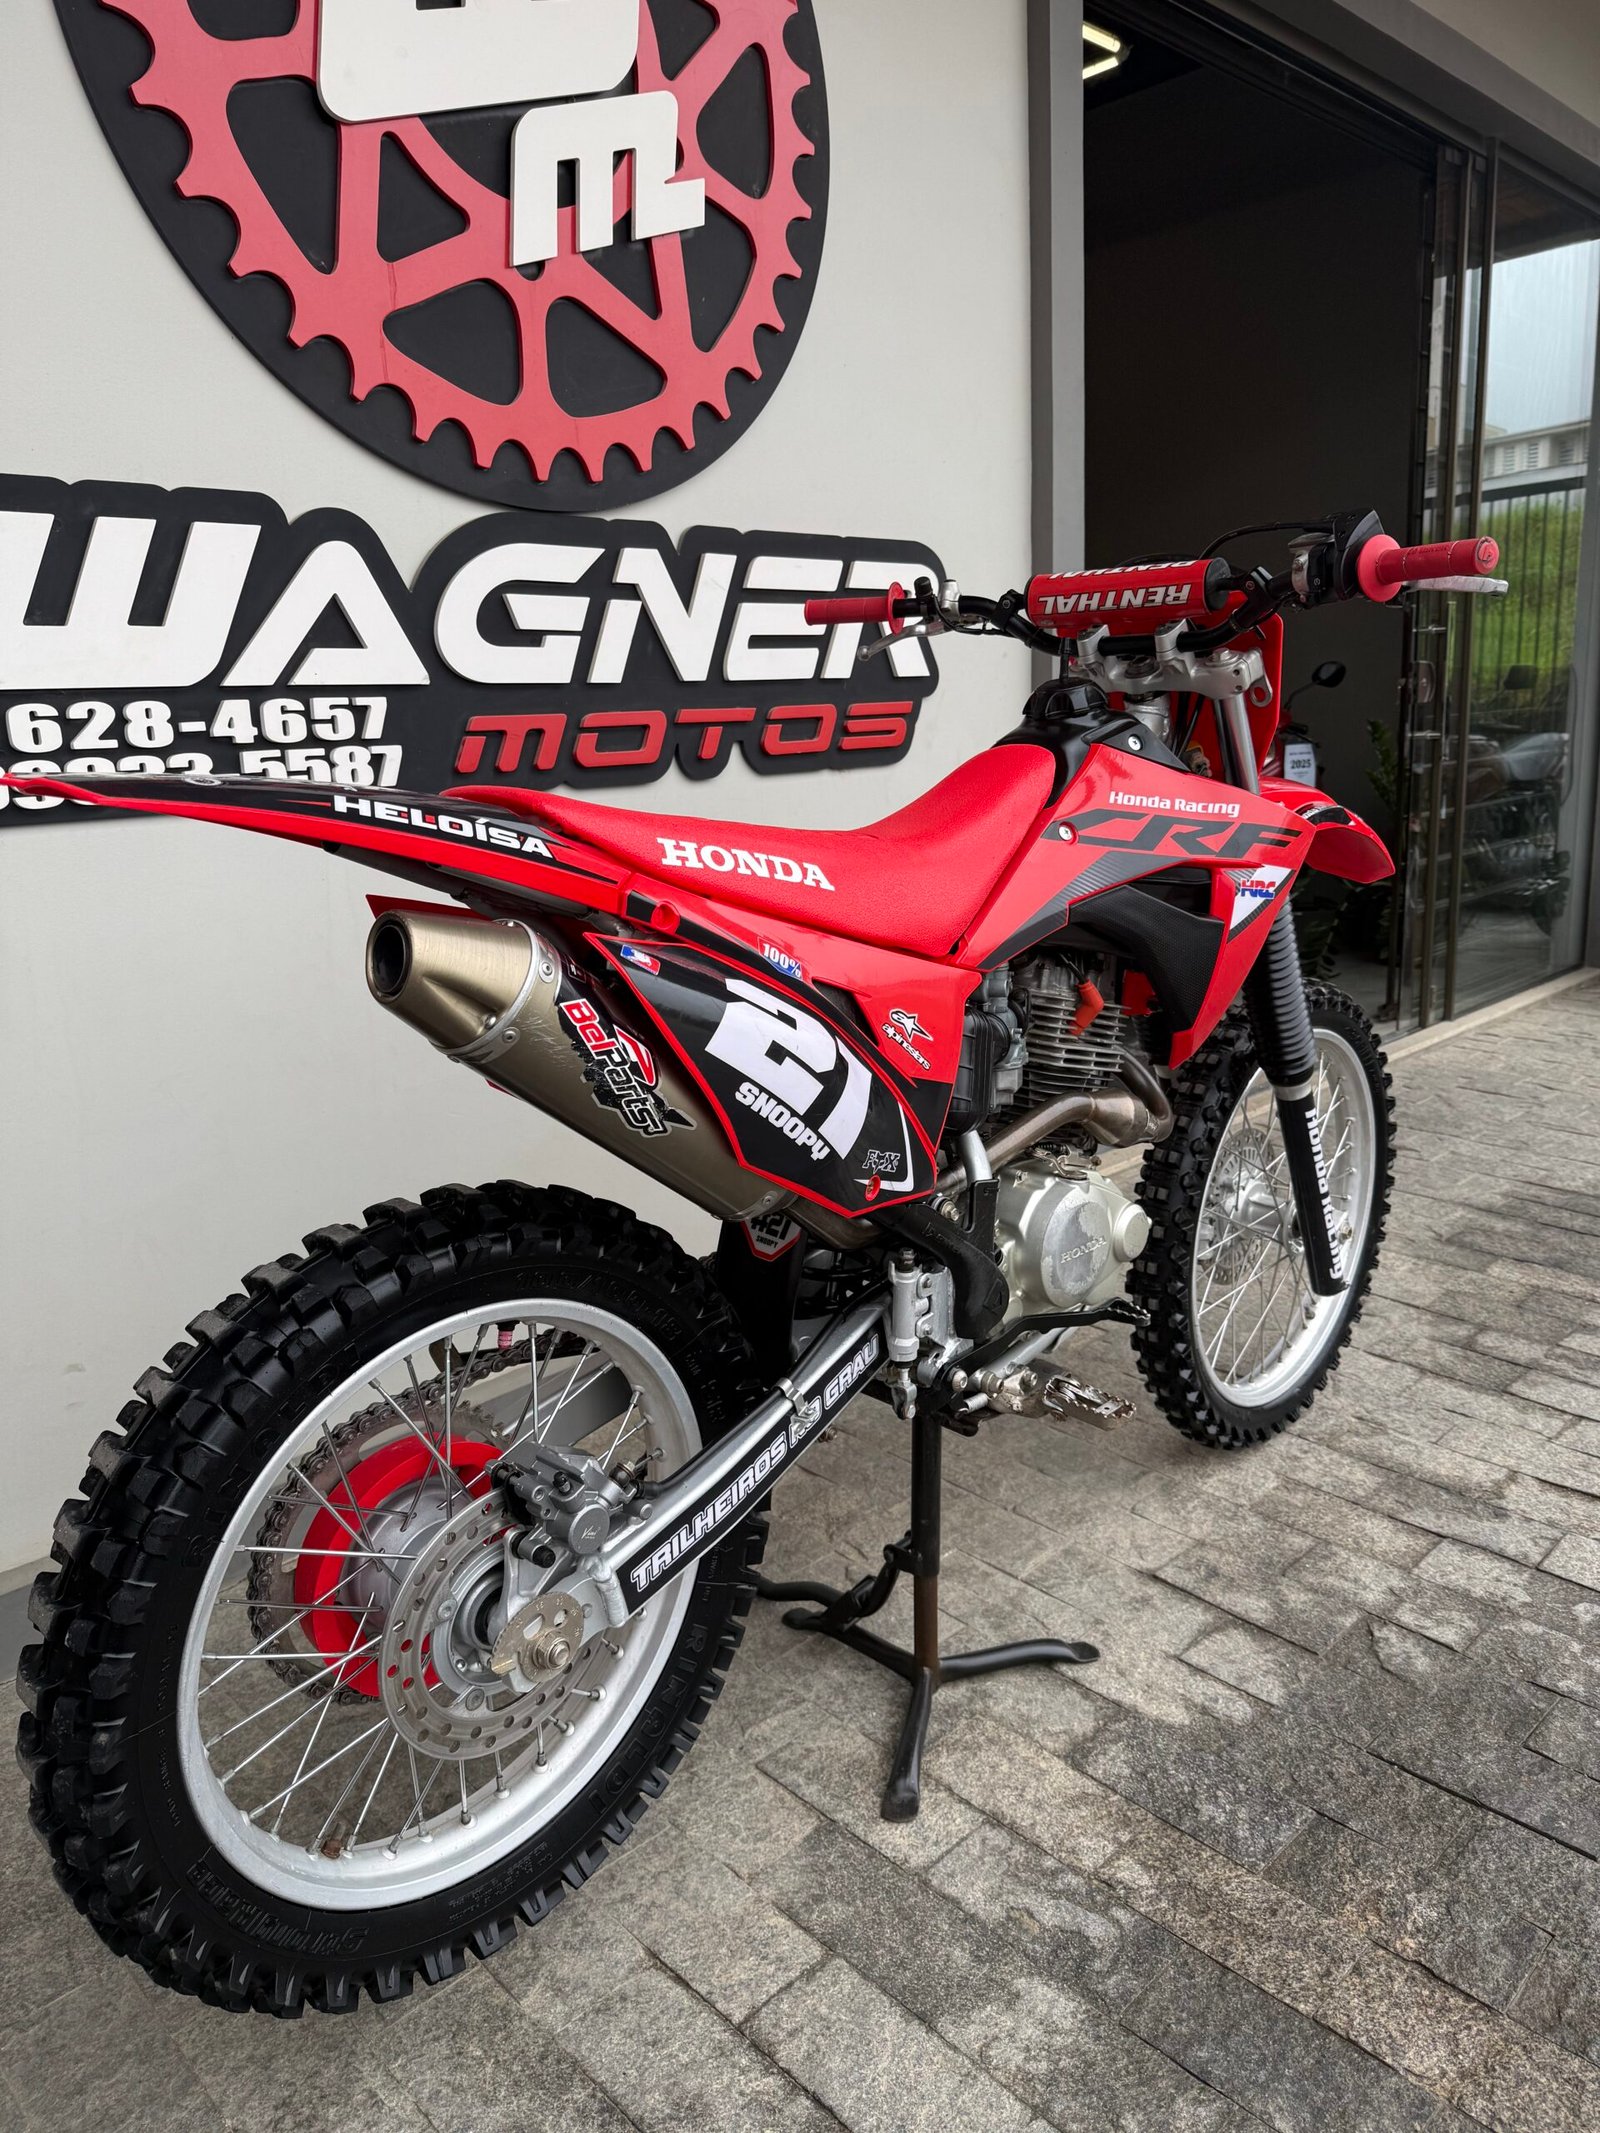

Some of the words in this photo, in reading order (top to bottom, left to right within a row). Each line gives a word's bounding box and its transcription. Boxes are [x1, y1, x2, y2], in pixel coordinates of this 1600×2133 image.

[0, 510, 938, 688] WAGNER
[1038, 583, 1192, 615] RENTHAL
[5, 696, 388, 754] 628-4657
[453, 701, 914, 775] MOTOS
[1109, 790, 1171, 811] Honda
[1174, 798, 1241, 818] Racing
[1040, 808, 1303, 859] CRF
[656, 837, 836, 892] HONDA
[1241, 879, 1276, 898] HRC
[762, 943, 801, 978] 100%
[881, 1022, 933, 1071] alpinestars
[734, 1081, 831, 1161] SNOOPY
[1060, 1236, 1107, 1263] HONDA
[630, 1431, 788, 1593] TRILHEIROS
[823, 1333, 880, 1411] GRAU
